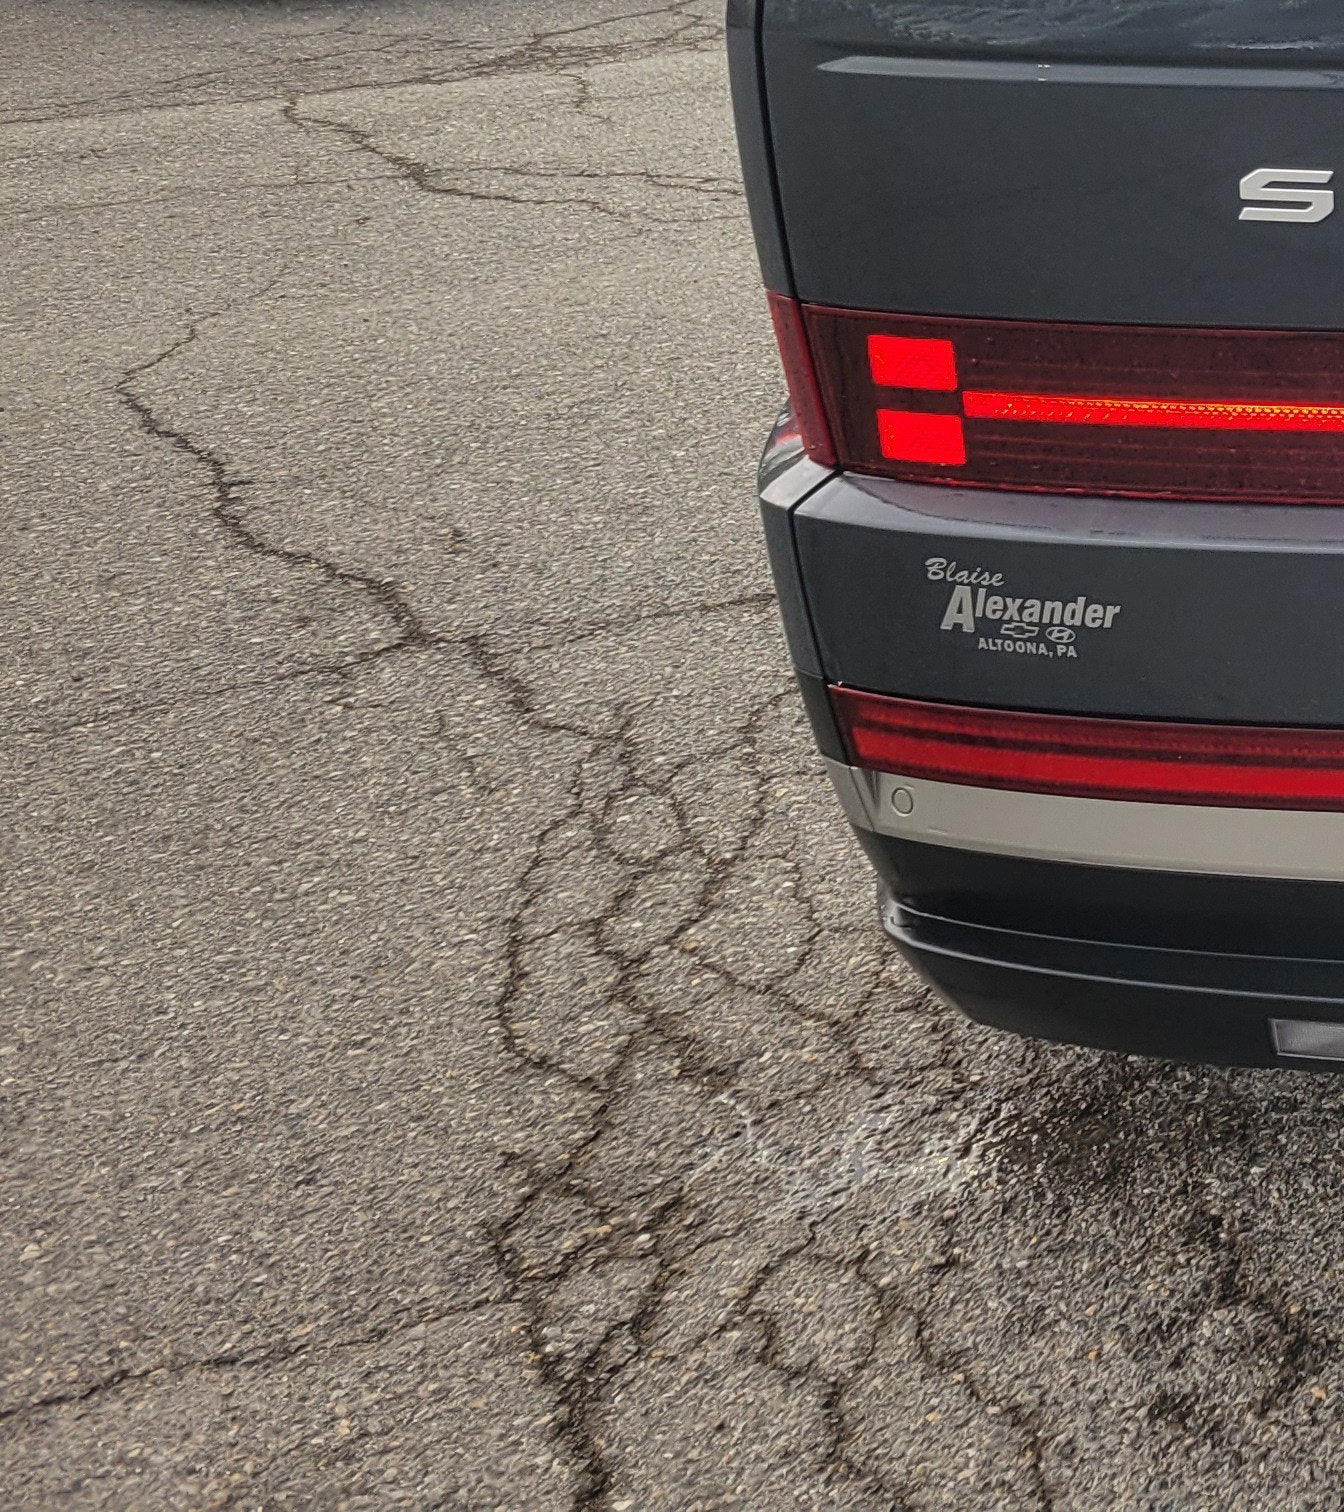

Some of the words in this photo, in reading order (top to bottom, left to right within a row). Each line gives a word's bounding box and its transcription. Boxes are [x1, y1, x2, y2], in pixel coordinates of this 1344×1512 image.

[925, 557, 1005, 586] Blaise
[940, 585, 1121, 632] Alexander
[978, 637, 1053, 658] ALTOONA,
[1057, 644, 1078, 658] PA
